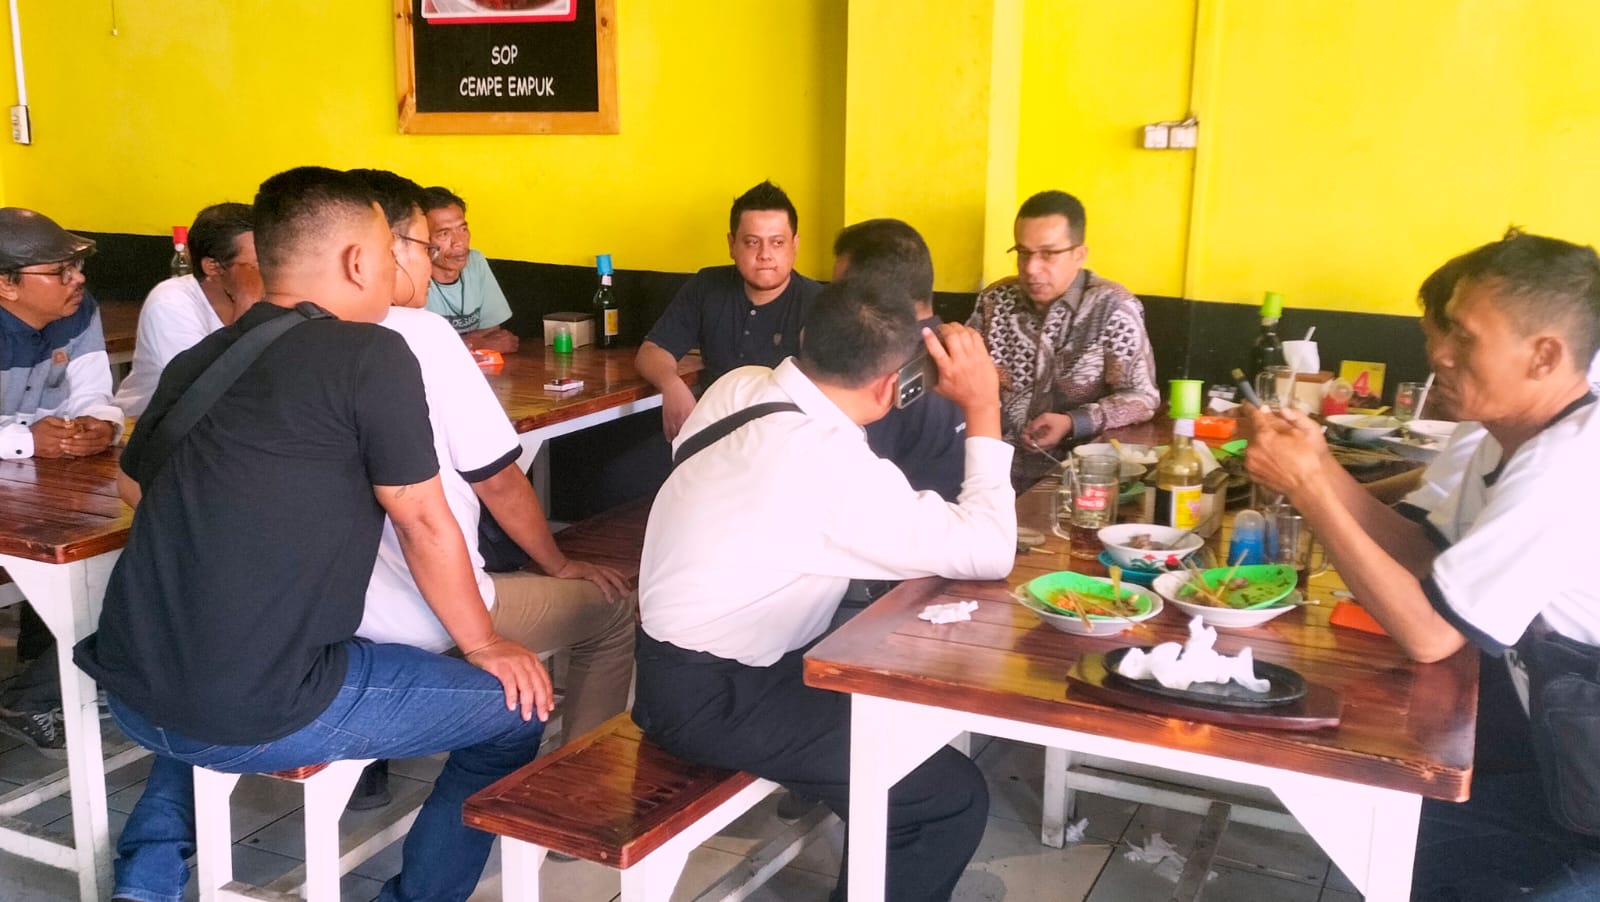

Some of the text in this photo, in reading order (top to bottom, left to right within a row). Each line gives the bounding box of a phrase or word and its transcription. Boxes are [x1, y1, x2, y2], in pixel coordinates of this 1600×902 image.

[491, 44, 519, 65] SOP
[459, 76, 555, 97] CEMPE EMPUK
[1351, 369, 1370, 397] 4
